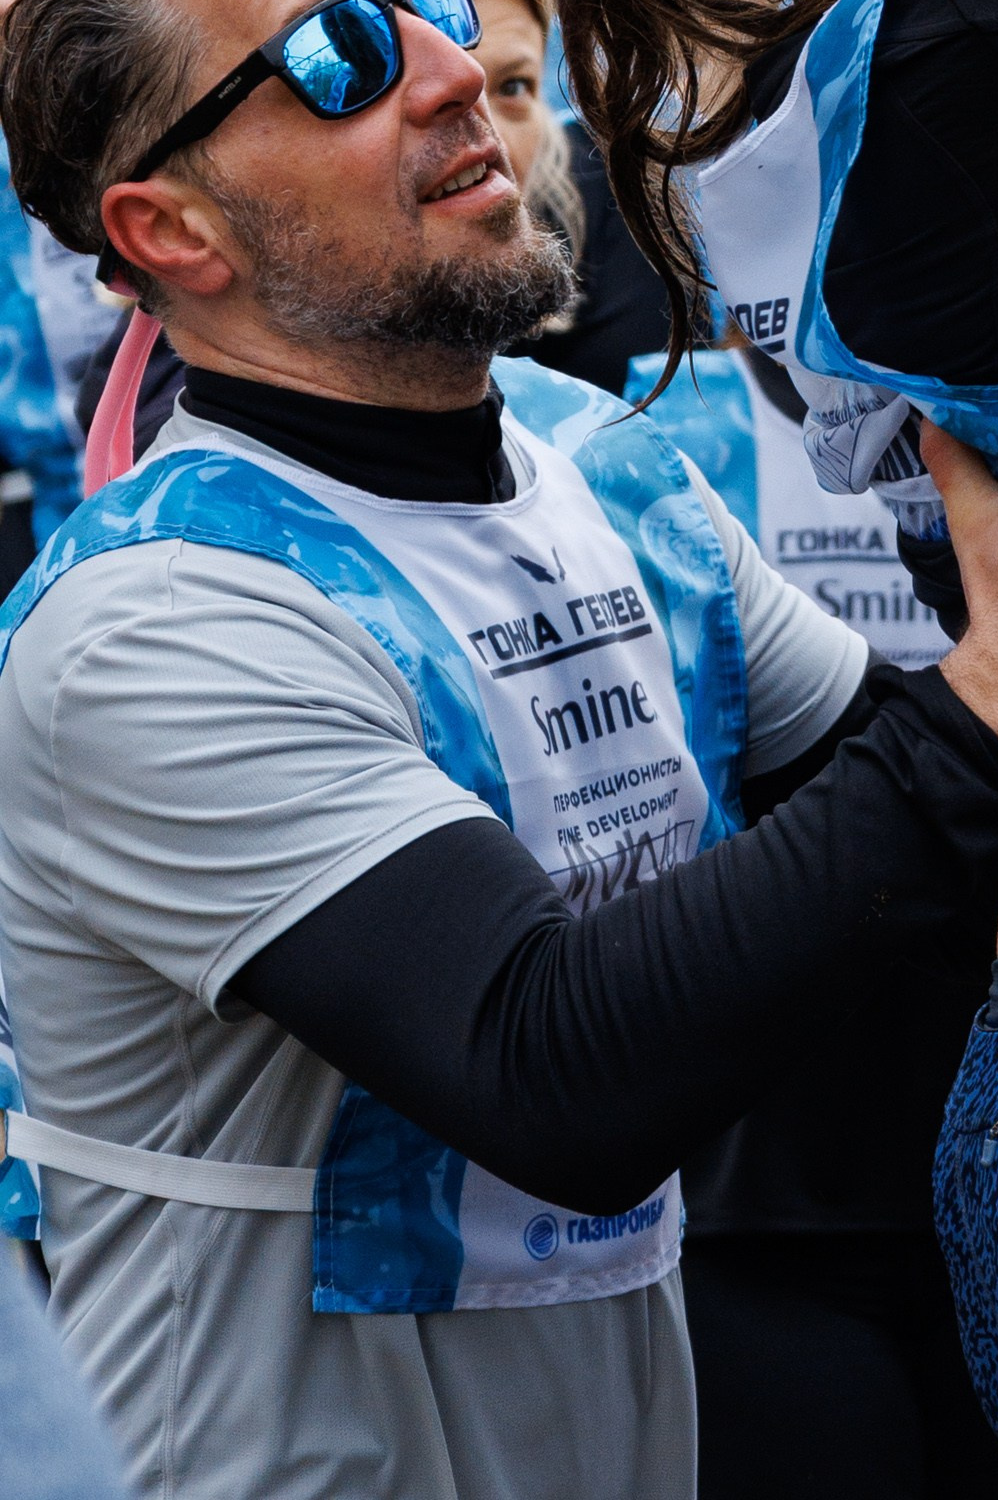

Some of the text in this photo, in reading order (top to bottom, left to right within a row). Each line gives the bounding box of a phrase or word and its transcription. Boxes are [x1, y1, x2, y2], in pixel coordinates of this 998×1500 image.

[727, 297, 789, 341] ОЕВ
[778, 528, 885, 553] ГОНКА
[467, 585, 646, 665] ГОНКА ГЕОЕВ
[531, 678, 658, 757] Smine
[554, 756, 682, 813] ПЕРФЕКЦИОНИСТЫ
[557, 825, 583, 846] FINE
